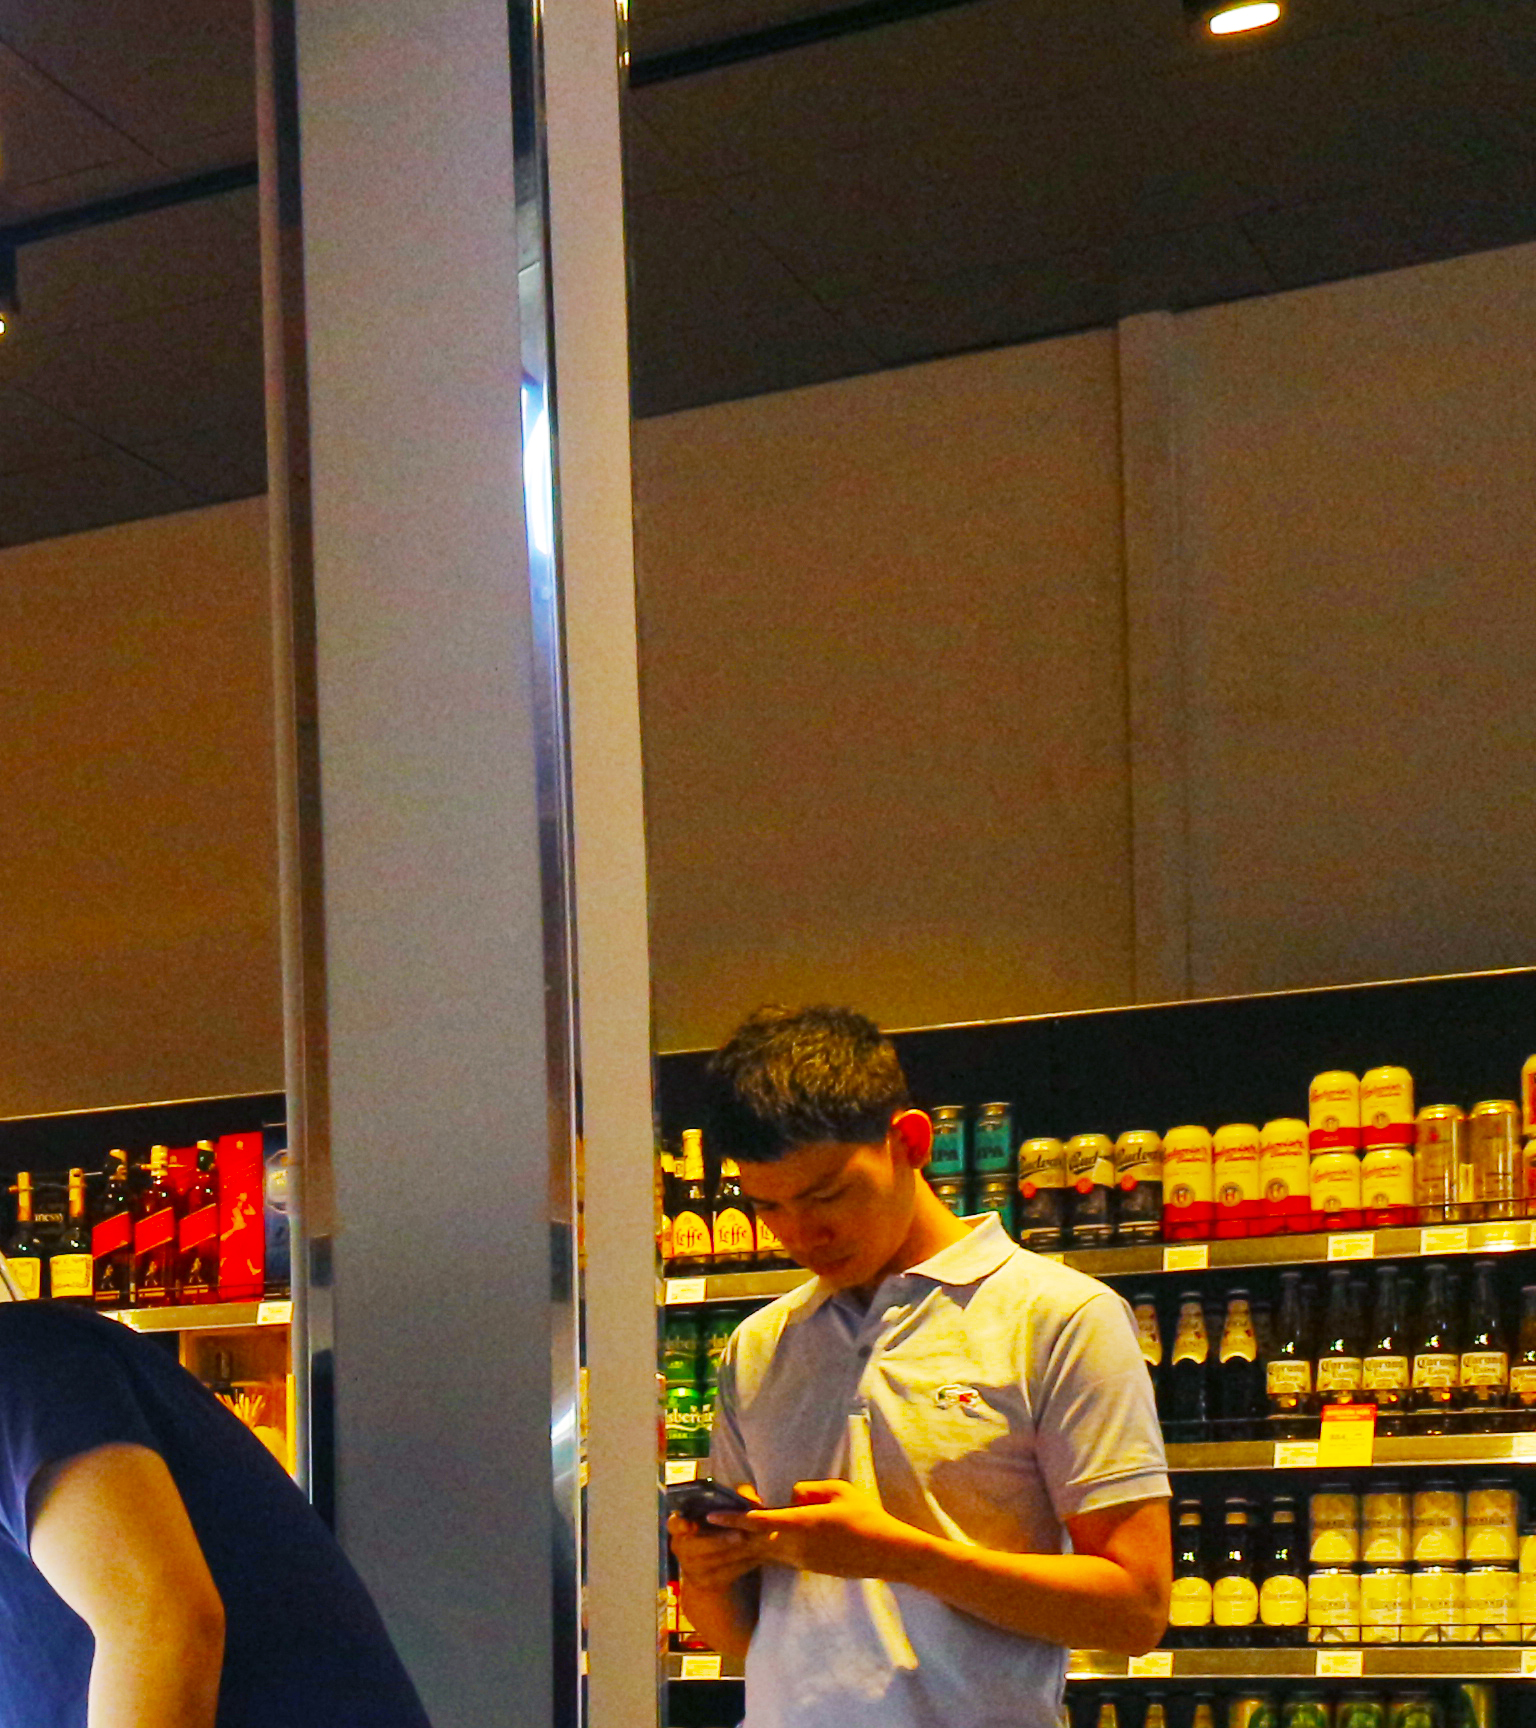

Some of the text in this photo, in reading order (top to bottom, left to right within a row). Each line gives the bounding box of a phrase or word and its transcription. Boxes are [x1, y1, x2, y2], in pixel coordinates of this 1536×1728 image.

[677, 1226, 703, 1249] Leffe
[719, 1223, 747, 1246] Leffe
[1320, 1360, 1361, 1373] Corona
[1364, 1359, 1404, 1371] Corona
[1417, 1357, 1457, 1370] Corona
[1463, 1354, 1505, 1368] Corona
[1269, 1364, 1307, 1375] Corona
